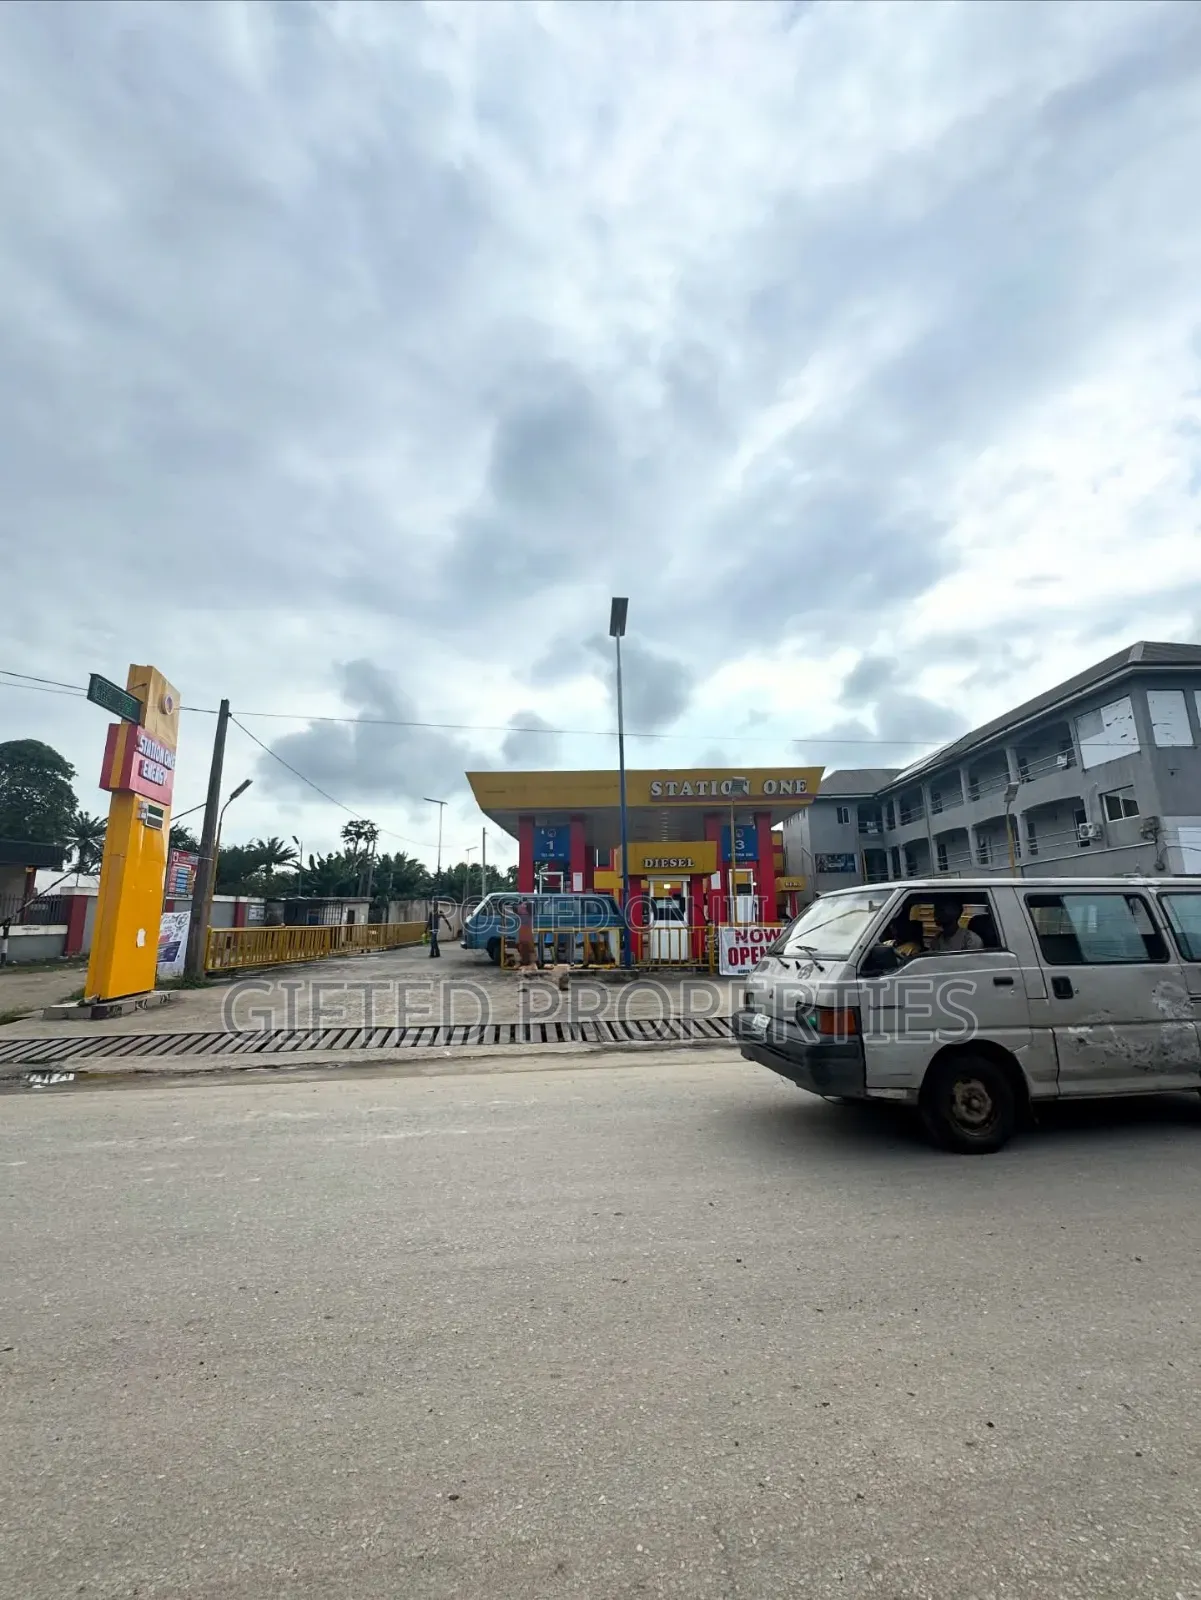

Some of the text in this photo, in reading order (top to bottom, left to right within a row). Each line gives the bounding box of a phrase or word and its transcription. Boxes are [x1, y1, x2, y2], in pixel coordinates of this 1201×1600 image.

[763, 779, 808, 795] ONE
[546, 840, 554, 850] 1
[735, 839, 745, 850] 3
[644, 858, 695, 868] DIESEL
[735, 928, 782, 944] NOW
